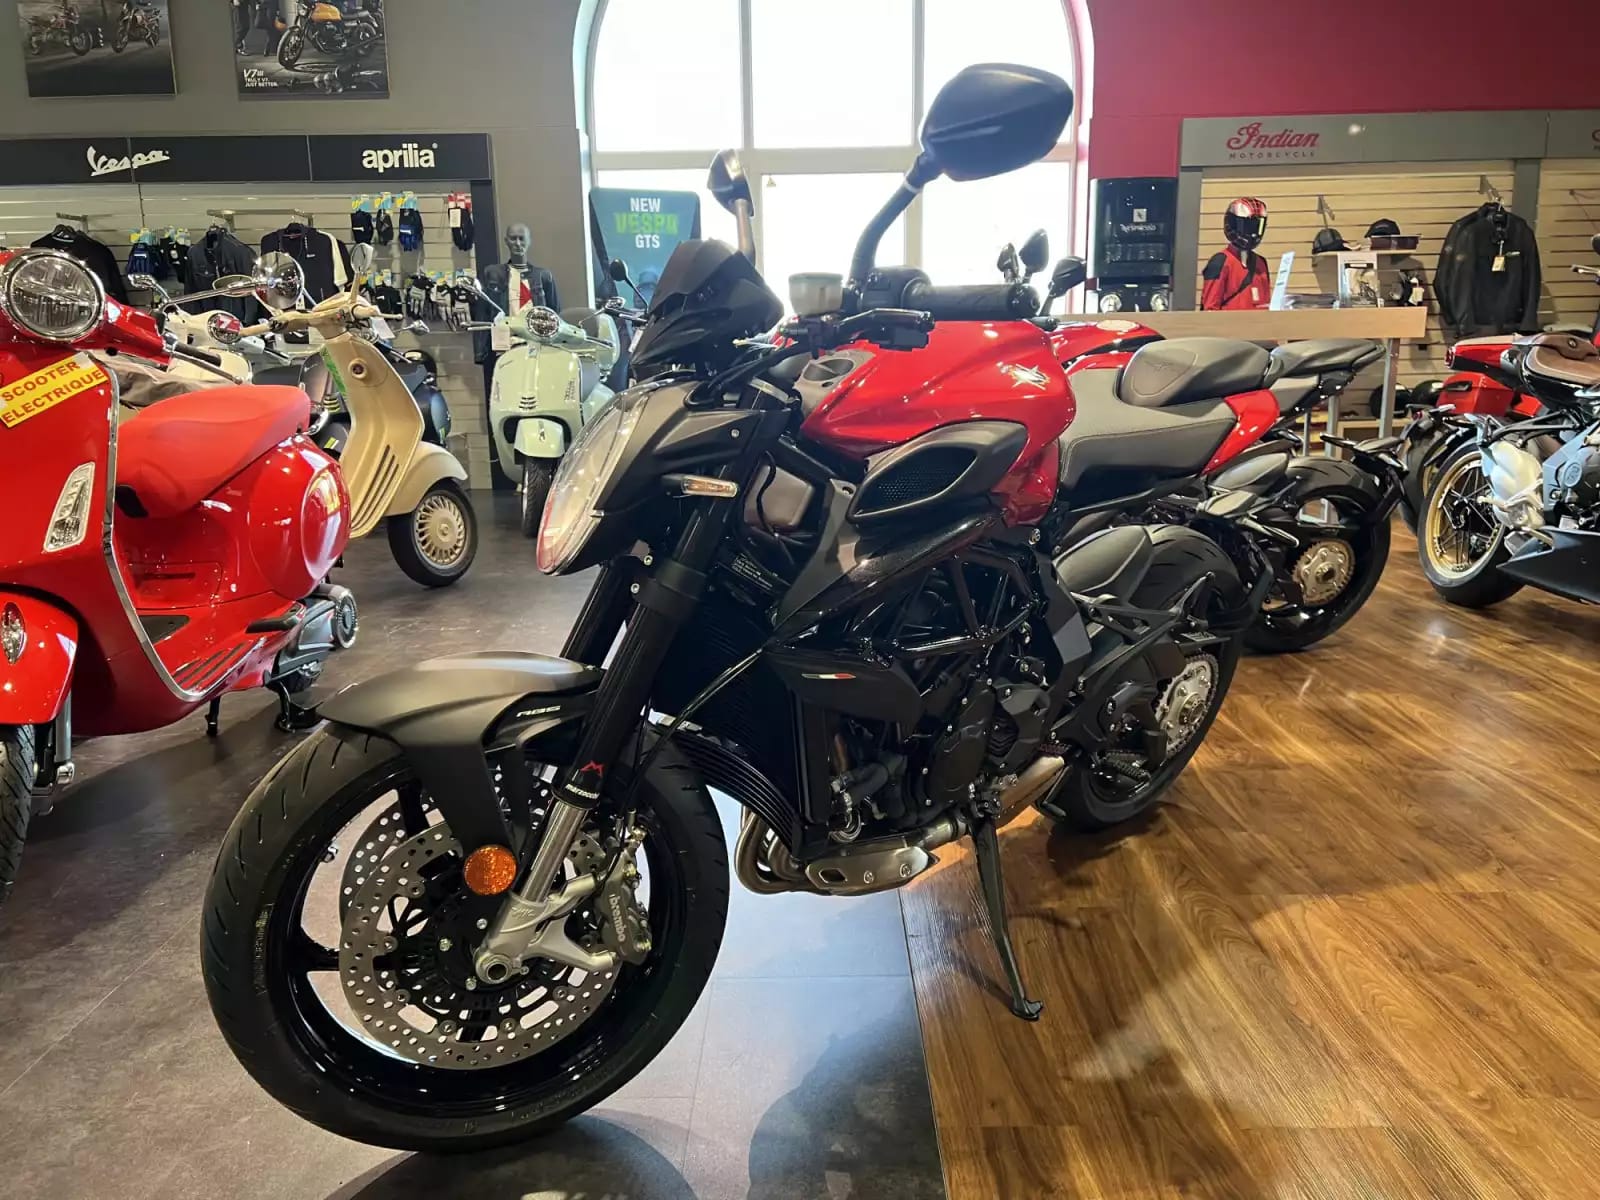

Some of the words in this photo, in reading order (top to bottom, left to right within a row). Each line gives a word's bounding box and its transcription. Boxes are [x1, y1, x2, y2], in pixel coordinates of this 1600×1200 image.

[243, 68, 258, 78] V7
[1226, 122, 1320, 150] Indian
[87, 145, 170, 176] Vespa
[362, 143, 435, 173] aprilia
[1229, 151, 1315, 159] MOTORCYCLE
[630, 197, 661, 212] NEW
[614, 212, 678, 235] VESPA
[635, 234, 660, 248] GTS
[1, 361, 80, 401] SCOOTER
[2, 370, 105, 423] ELECTRIQUE
[609, 895, 627, 942] brembo
